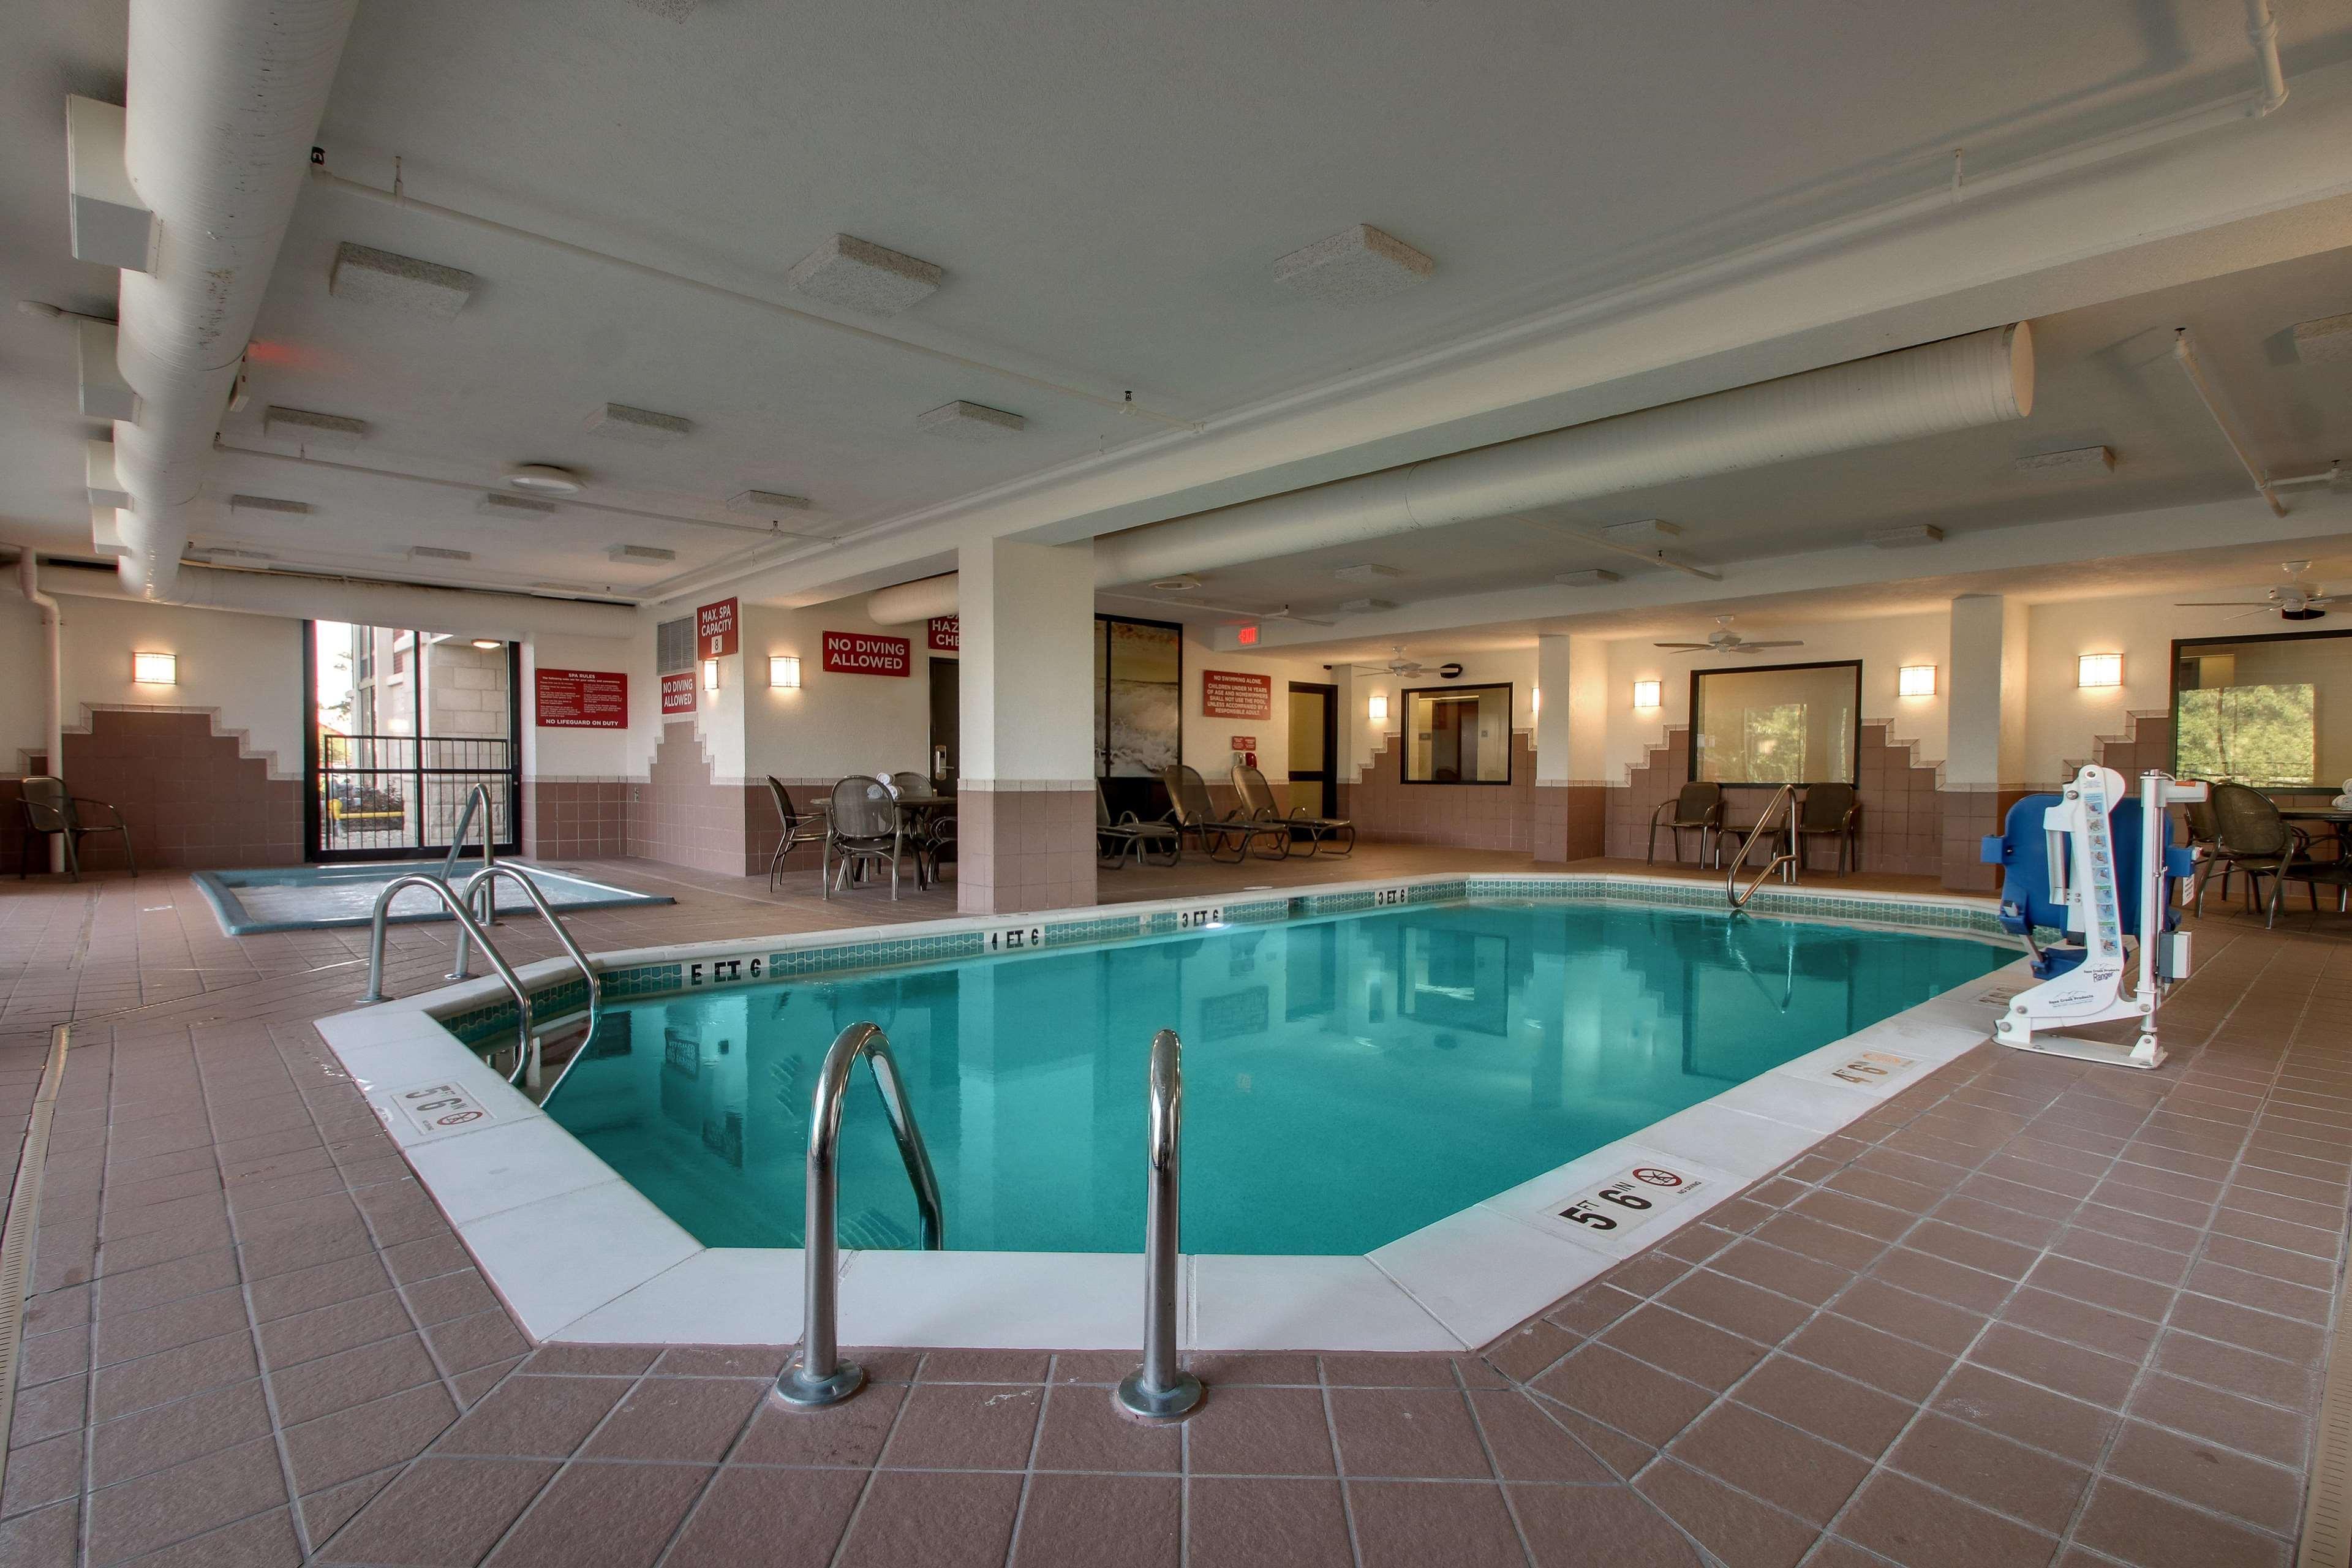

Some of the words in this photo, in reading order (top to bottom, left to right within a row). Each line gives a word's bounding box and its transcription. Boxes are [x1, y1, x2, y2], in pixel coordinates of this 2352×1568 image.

[702, 609, 718, 624] MAX.
[719, 604, 731, 619] SPA
[701, 618, 733, 637] CAPACITY
[932, 620, 959, 633] HAZ
[1241, 627, 1256, 644] EXIT
[714, 639, 719, 650] 8
[828, 638, 851, 652] NO
[856, 640, 905, 655] DIVING
[830, 653, 903, 669] ALLOWED
[663, 681, 672, 693] NO
[673, 678, 693, 691] DIVING
[664, 693, 692, 707] ALLOWED
[2093, 971, 2114, 982] Ranger
[405, 1085, 451, 1099] 5
[417, 1098, 462, 1111] 6
[1612, 1181, 1637, 1192] IN
[1684, 1181, 1702, 1190] DIVING
[1575, 1200, 1600, 1211] FT
[1598, 1189, 1653, 1210] 6
[1558, 1207, 1618, 1231] 5
